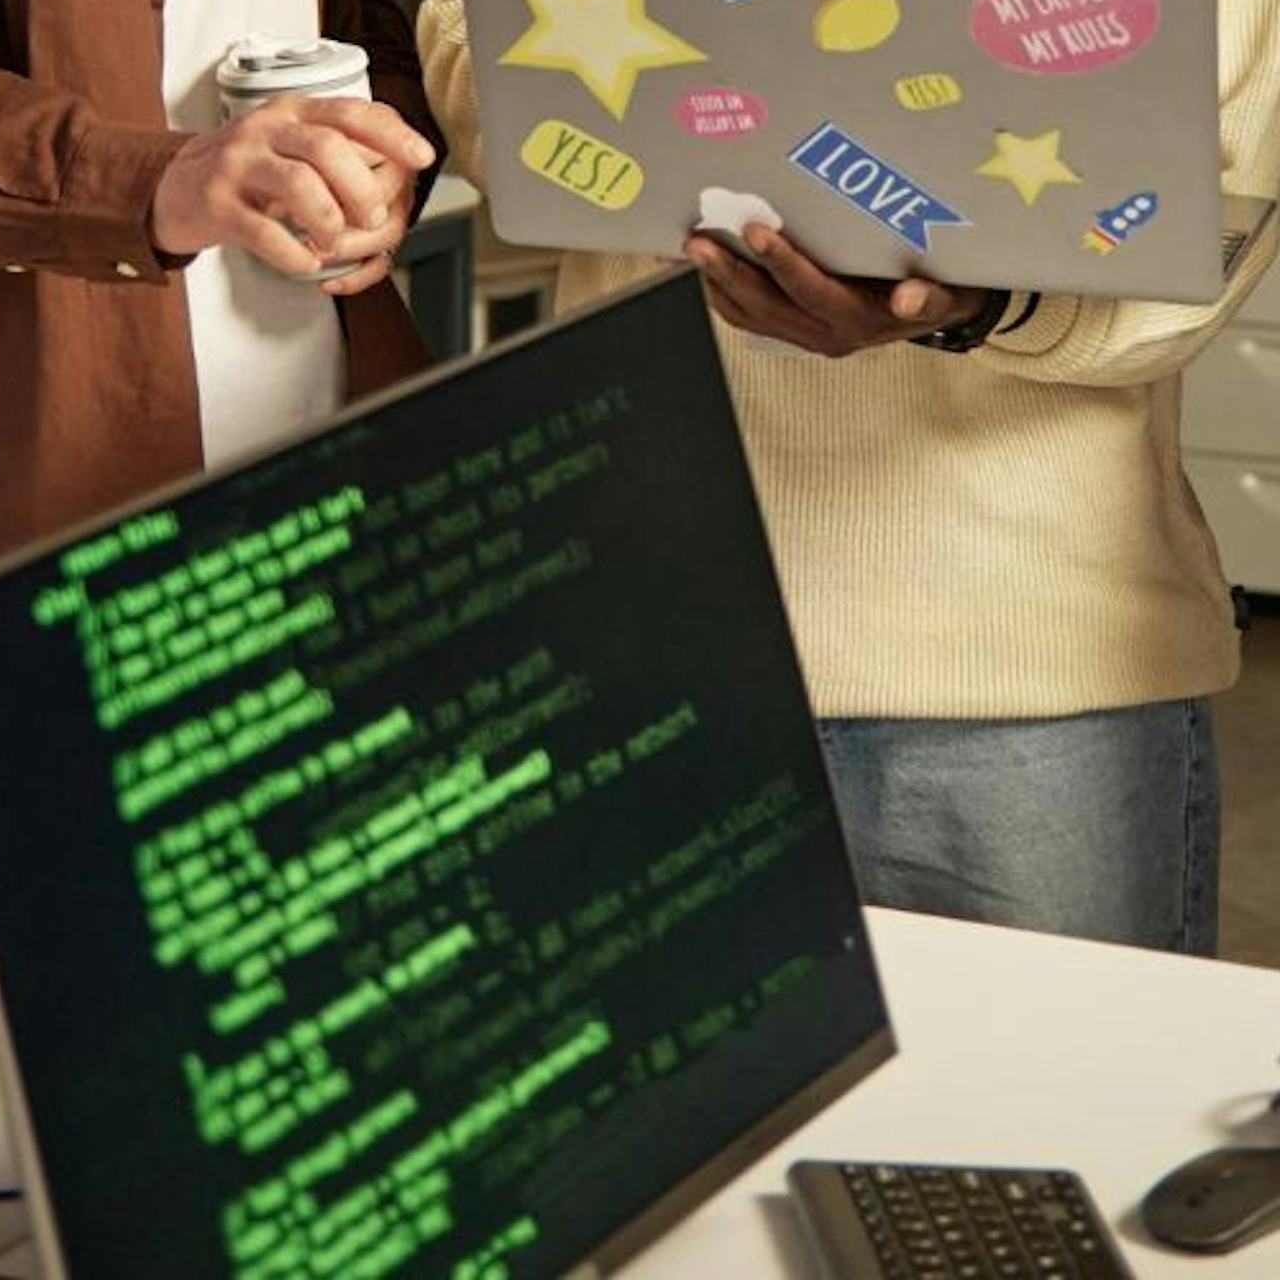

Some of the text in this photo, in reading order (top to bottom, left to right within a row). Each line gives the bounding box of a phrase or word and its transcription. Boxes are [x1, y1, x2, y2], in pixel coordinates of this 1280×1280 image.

[1020, 10, 1131, 65] MY RULES
[542, 128, 631, 201] YES!
[815, 141, 930, 231] LOVE
